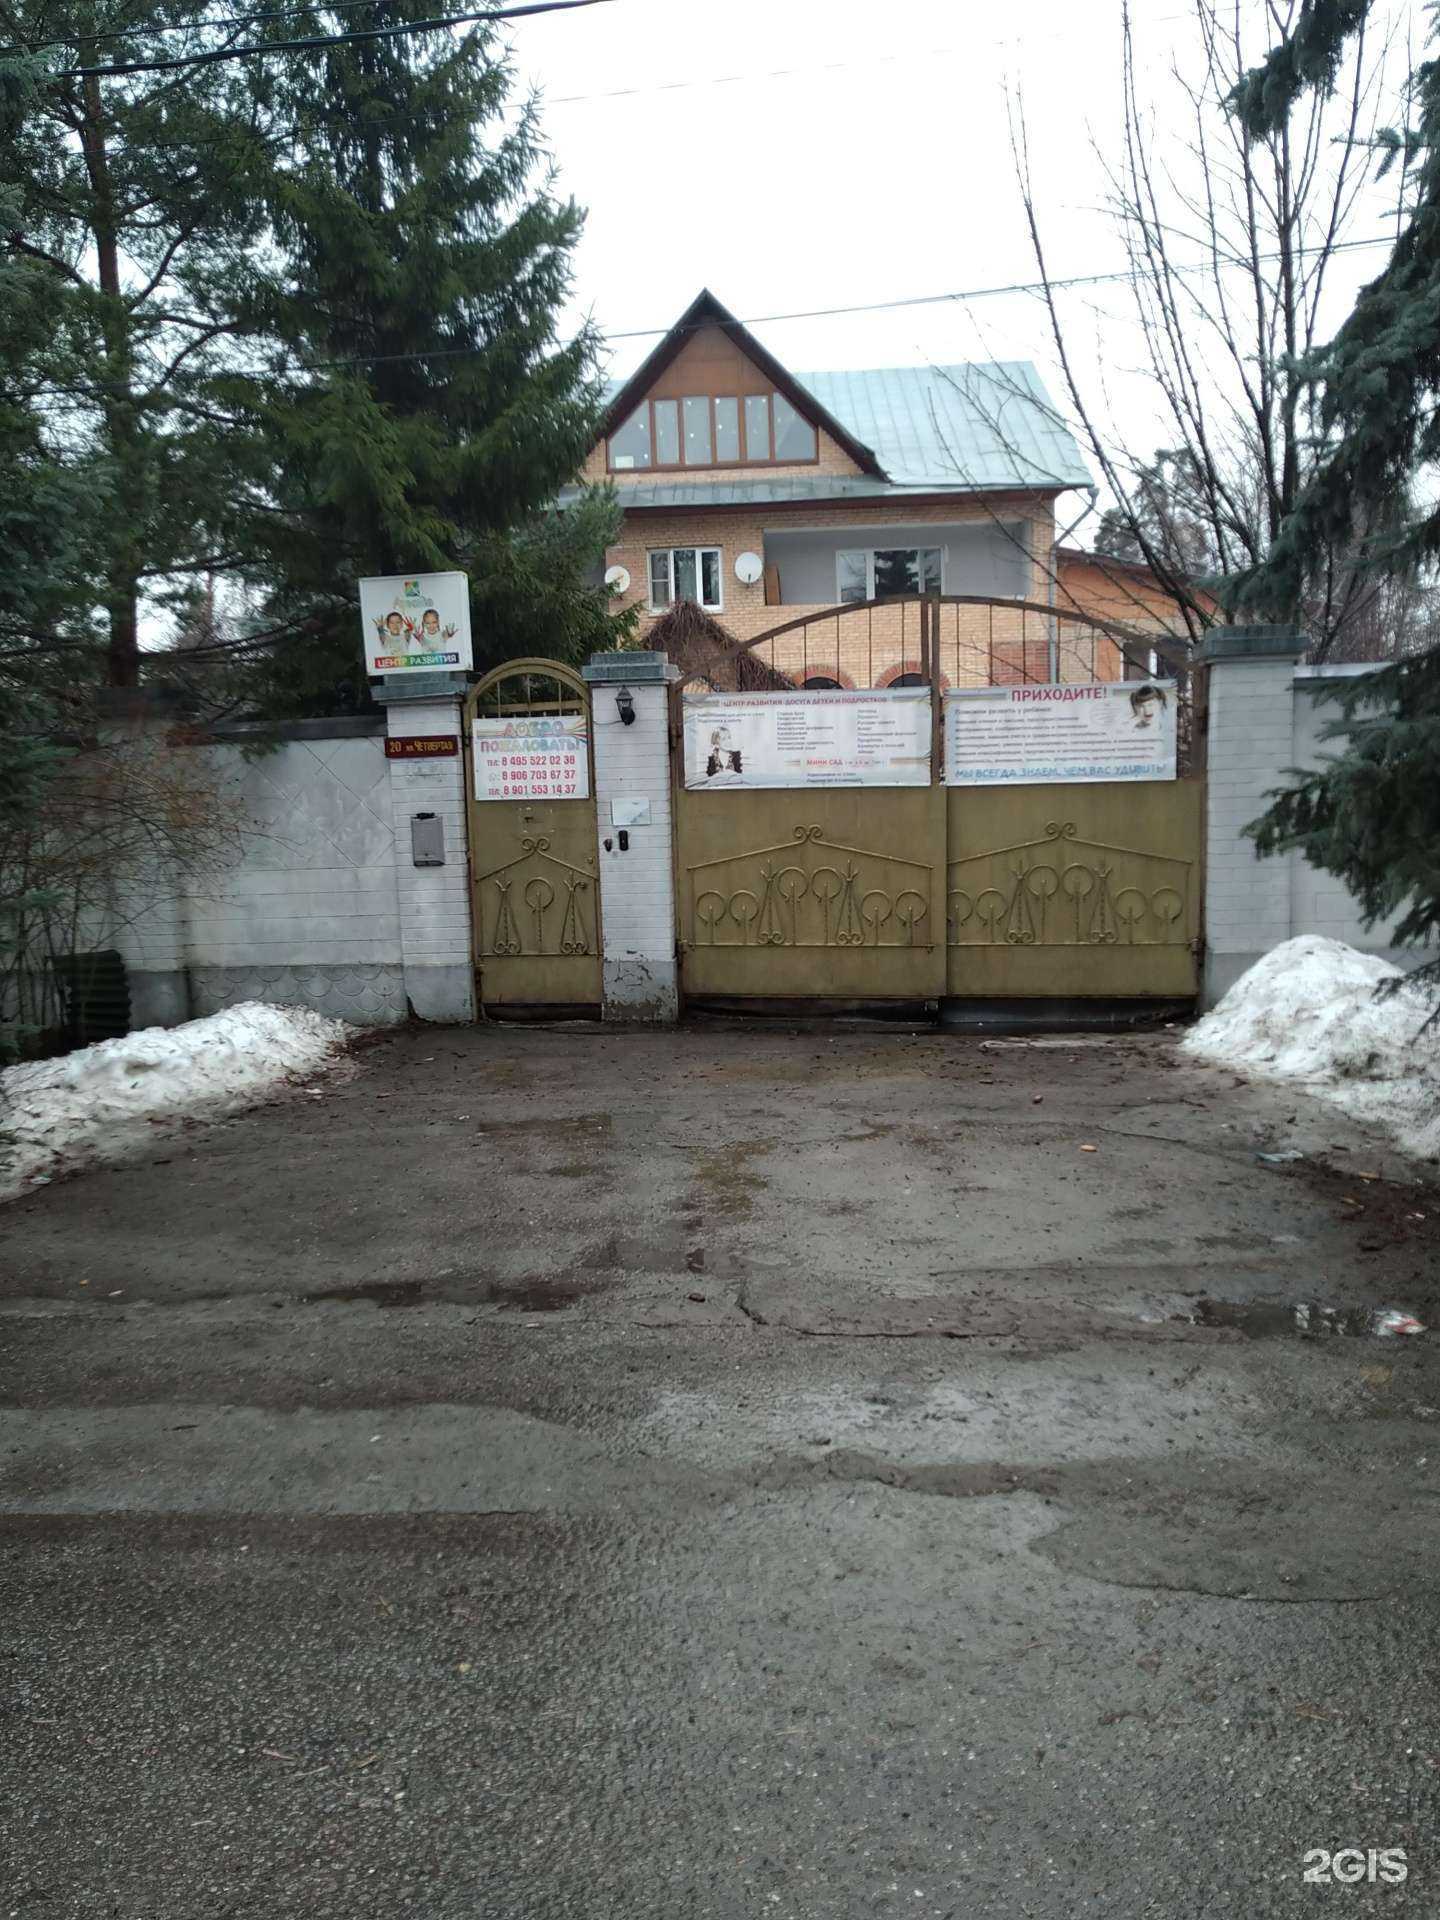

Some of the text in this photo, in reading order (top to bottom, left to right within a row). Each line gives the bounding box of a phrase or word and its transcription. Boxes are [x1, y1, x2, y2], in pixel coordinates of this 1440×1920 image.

[410, 654, 457, 665] РАЗВИТИЯ
[1011, 686, 1108, 702] ПРИХОДИТЕ!
[504, 721, 564, 737] ДОБРО
[480, 739, 580, 753] ПОЖАЛОВАТЬ!
[501, 756, 507, 766] 8
[510, 756, 528, 766] 495
[530, 756, 547, 766] 522
[549, 755, 561, 765] 02
[563, 755, 575, 765] 38
[502, 771, 508, 781] 8
[511, 770, 528, 780] 906
[530, 770, 547, 780] 703
[563, 769, 576, 779] 37
[503, 785, 510, 795] 8
[512, 785, 528, 795] 901
[531, 784, 548, 794] 553
[552, 784, 562, 794] 14
[564, 784, 576, 794] 37
